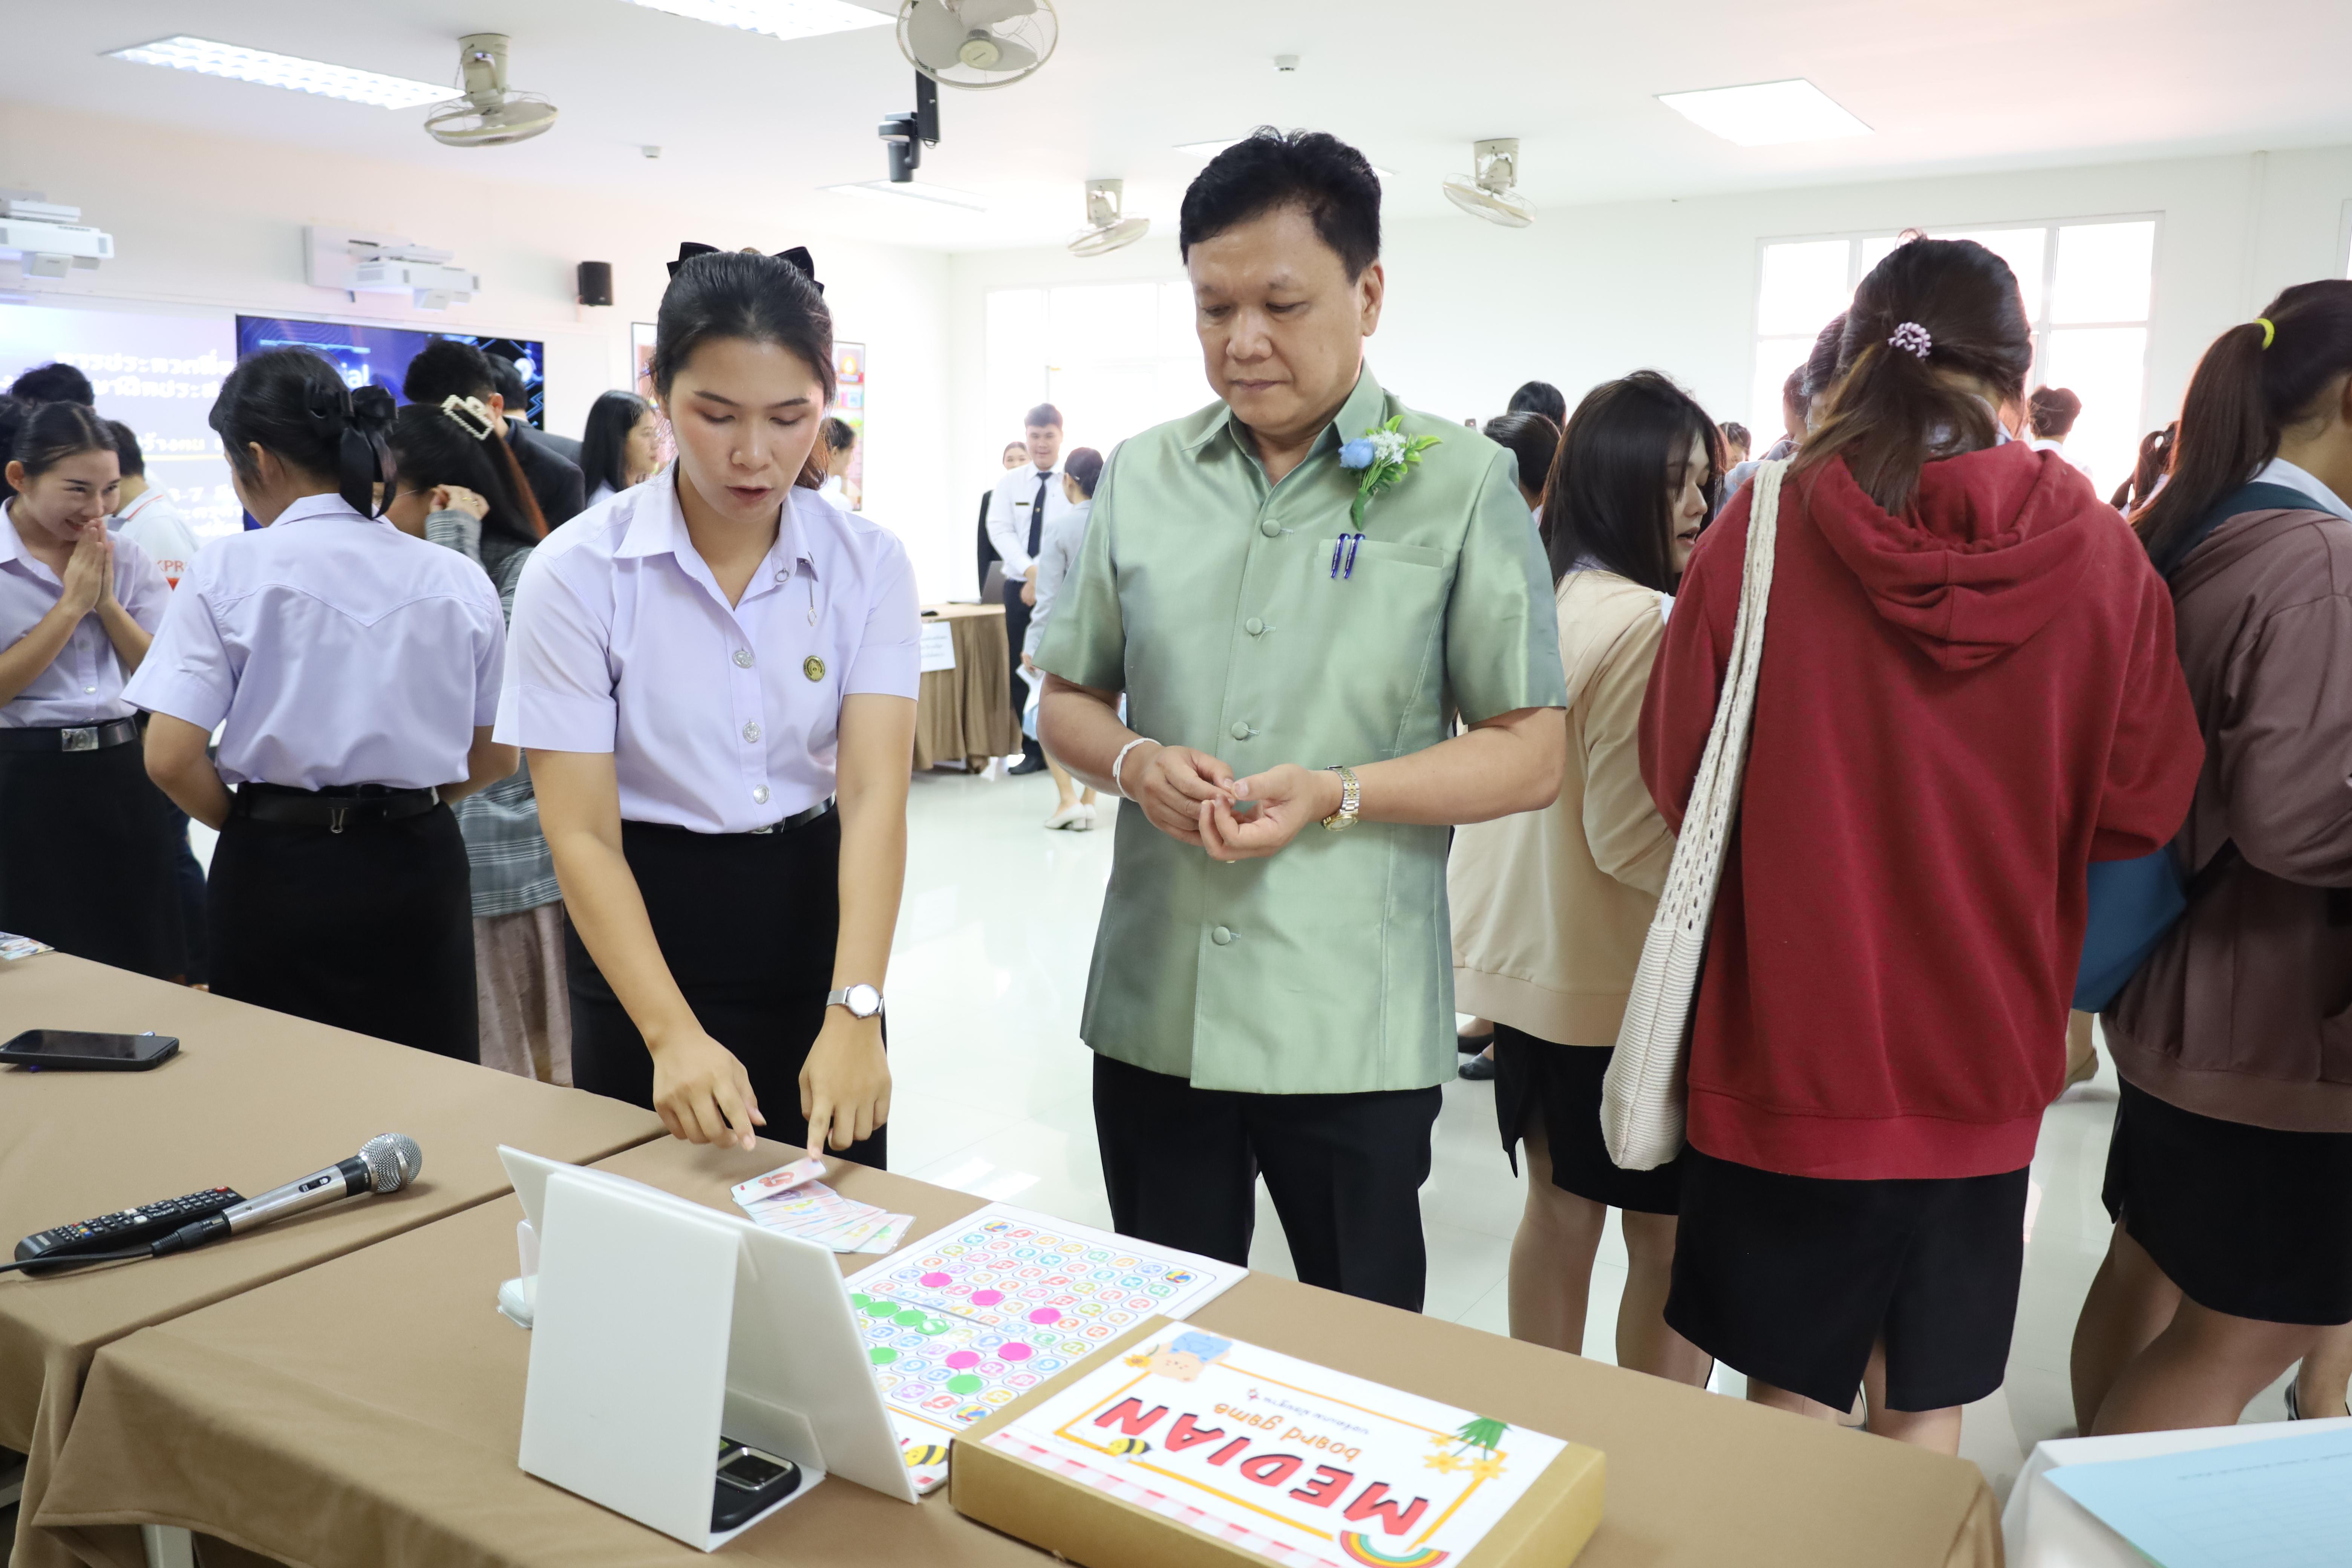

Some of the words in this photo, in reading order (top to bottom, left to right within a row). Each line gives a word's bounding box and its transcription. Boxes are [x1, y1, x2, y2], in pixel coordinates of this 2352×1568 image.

[157, 560, 187, 572] KPR
[1213, 1403, 1283, 1432] game
[1280, 1427, 1361, 1462] board
[1095, 1397, 1429, 1535] MEDIAN
